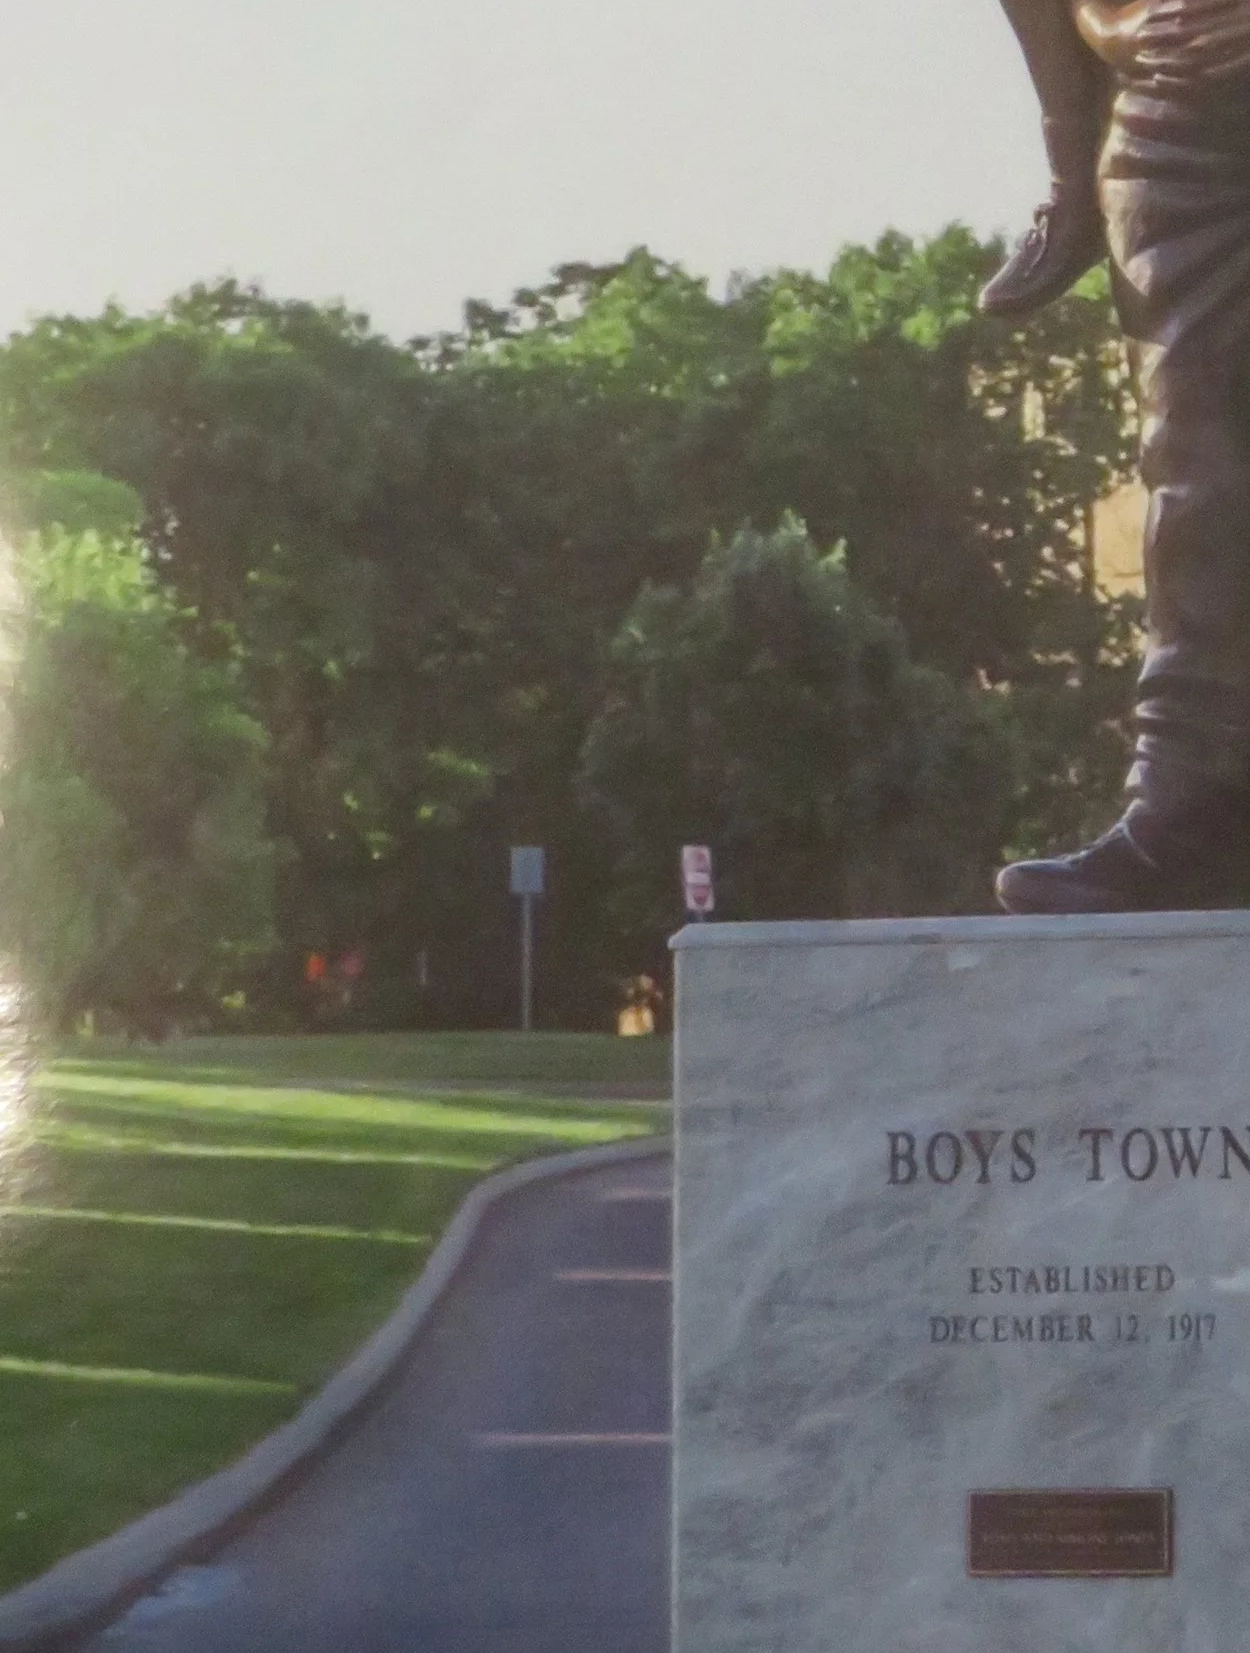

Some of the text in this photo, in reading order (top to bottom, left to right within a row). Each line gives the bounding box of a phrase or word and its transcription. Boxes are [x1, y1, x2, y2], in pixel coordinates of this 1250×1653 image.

[886, 1127, 1038, 1186] BOYS
[969, 1263, 1177, 1294] ESTABLISHED
[928, 1313, 1095, 1345] DECEMBER
[1168, 1311, 1218, 1342] 1917
